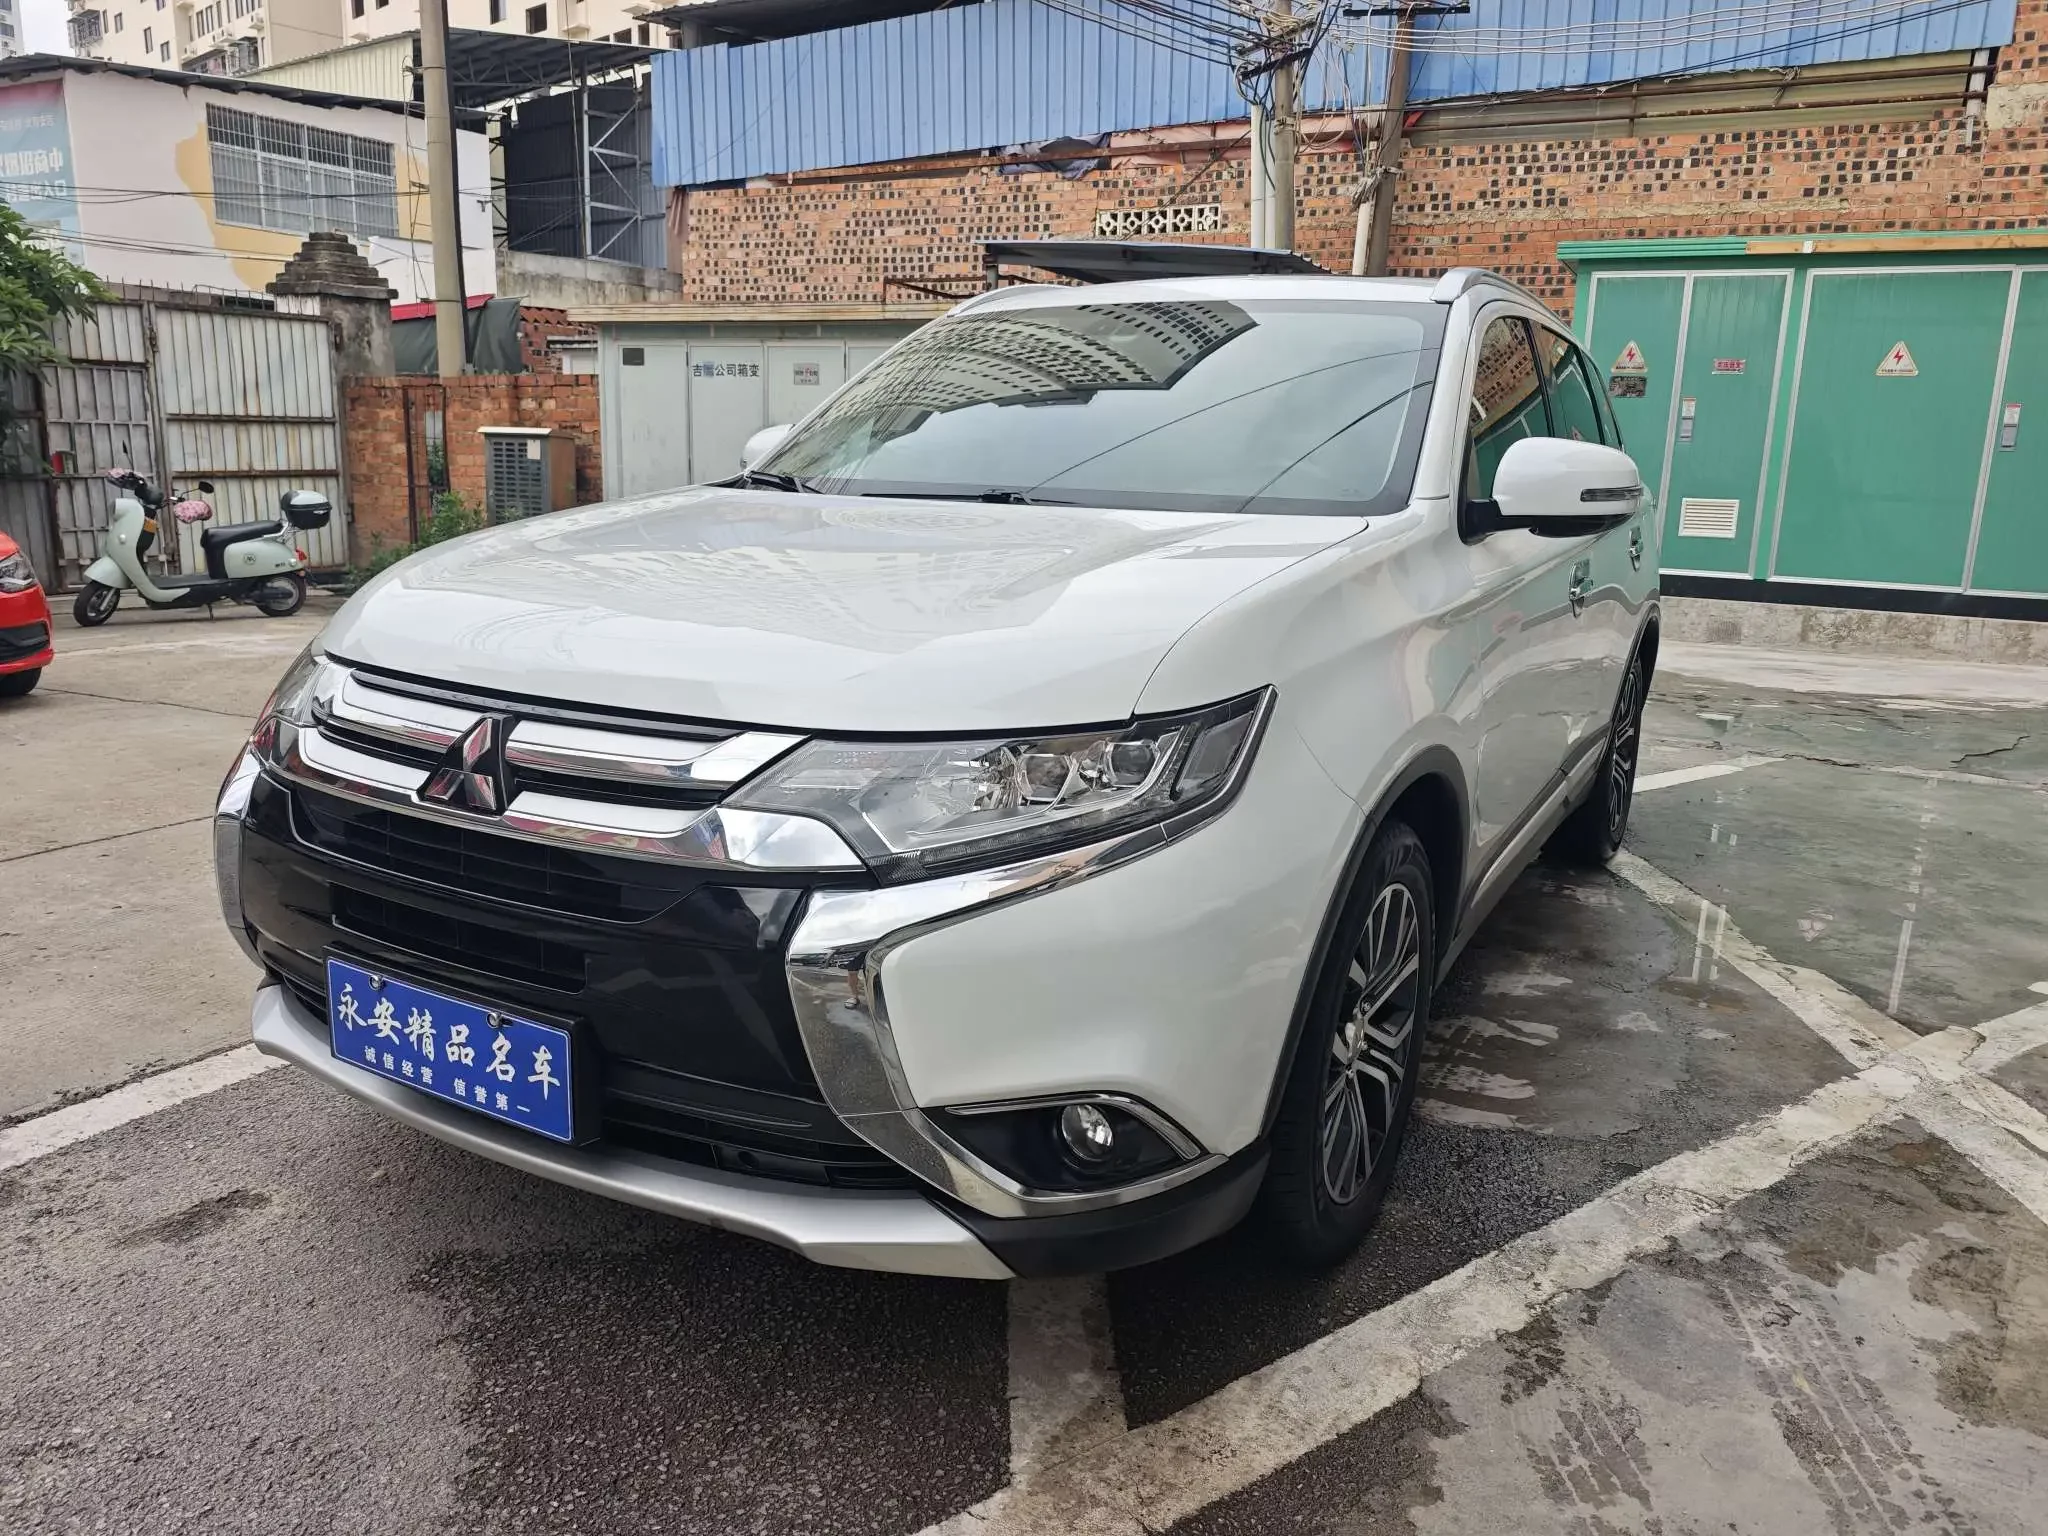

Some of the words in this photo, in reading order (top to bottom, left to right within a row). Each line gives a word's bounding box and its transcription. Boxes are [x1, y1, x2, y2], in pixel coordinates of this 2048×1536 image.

[337, 983, 560, 1100] 永安精品名车
[453, 1077, 531, 1112] 信誉第一
